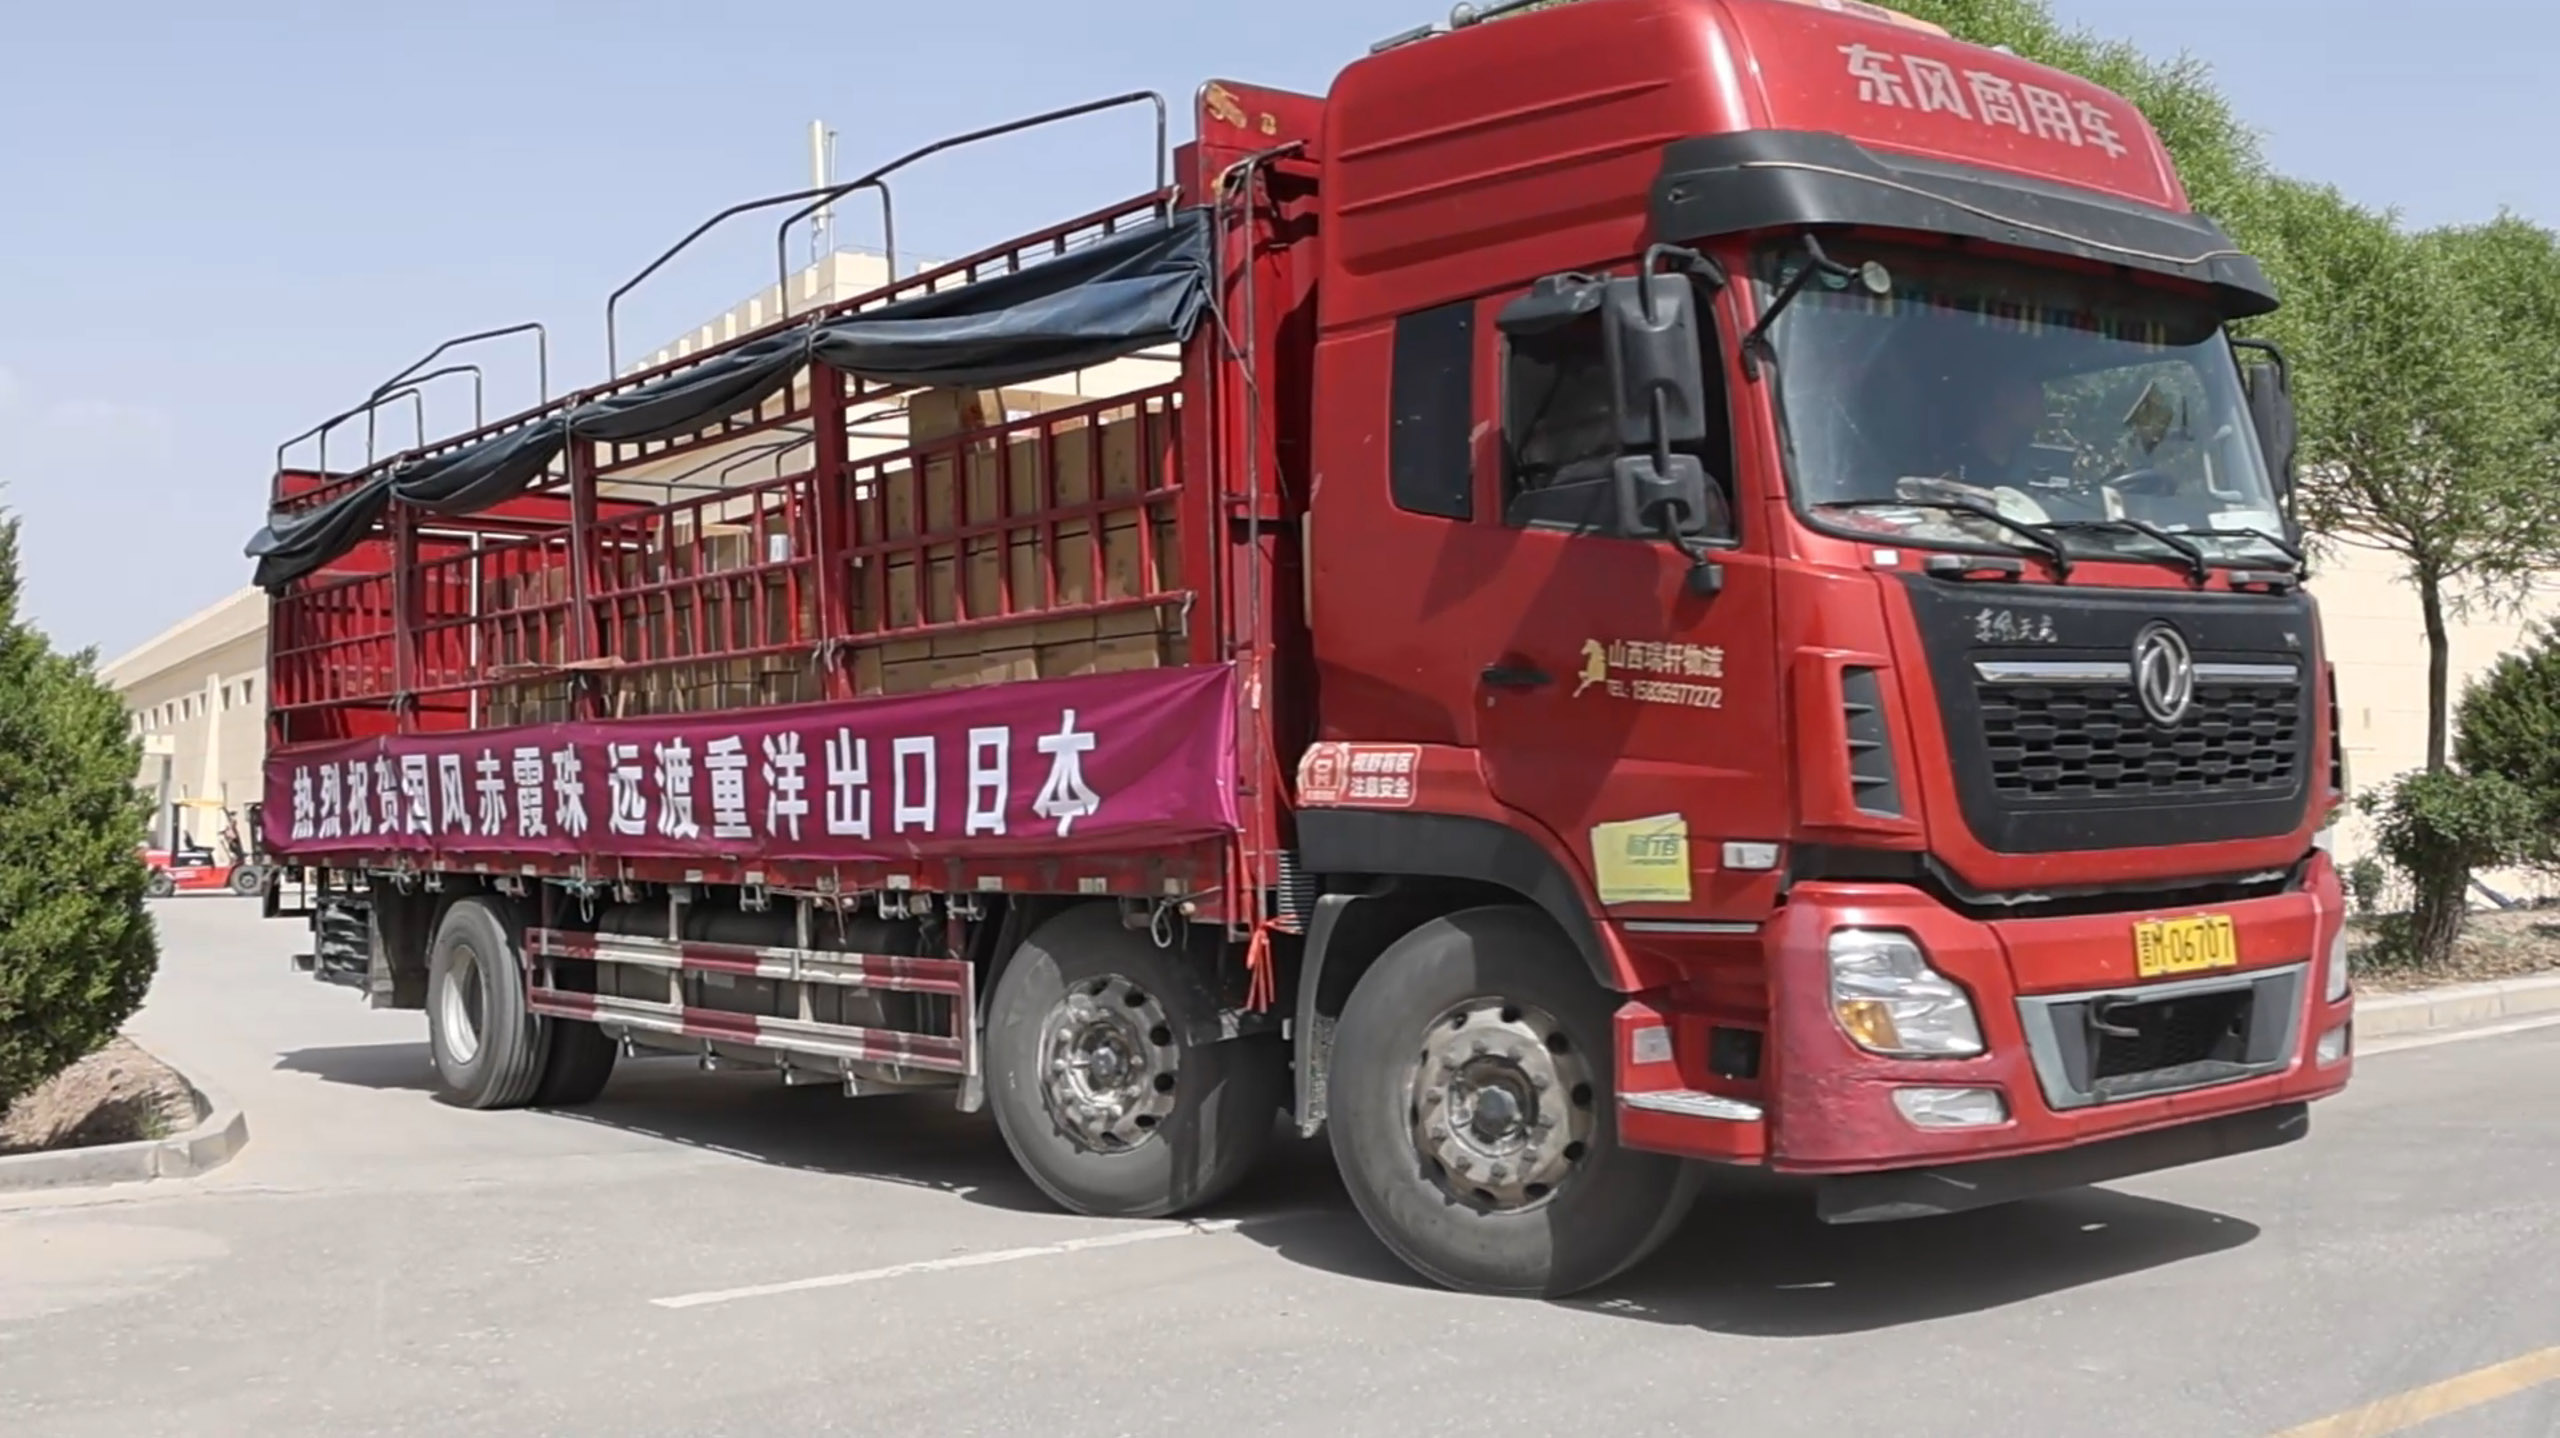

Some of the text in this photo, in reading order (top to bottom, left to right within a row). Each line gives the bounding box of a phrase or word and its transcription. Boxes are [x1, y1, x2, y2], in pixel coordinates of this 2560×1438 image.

[1837, 42, 2128, 160] 东风商用车
